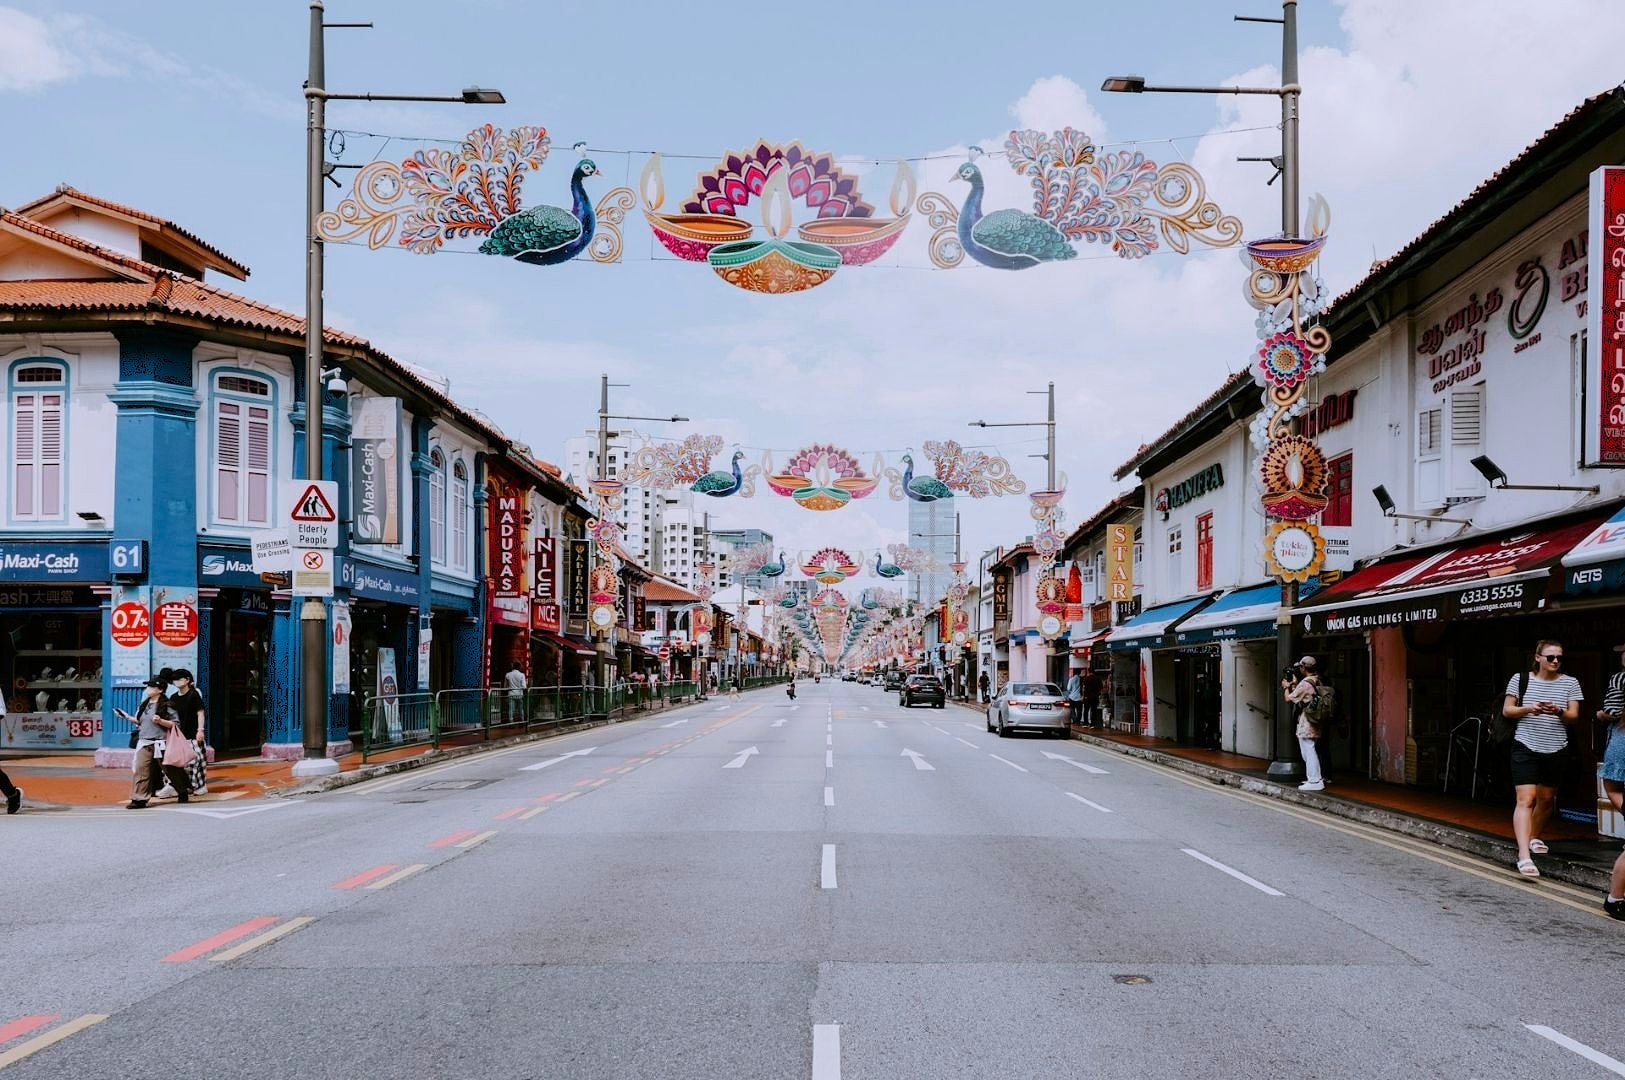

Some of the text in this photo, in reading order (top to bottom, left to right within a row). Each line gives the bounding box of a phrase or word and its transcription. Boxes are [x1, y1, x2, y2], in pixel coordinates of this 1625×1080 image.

[361, 443, 375, 514] Maxi-Cash
[298, 524, 328, 535] Elderly
[256, 539, 288, 549] PEDESTRIANS
[299, 535, 327, 545] People
[500, 497, 515, 591] MADURAS
[4, 553, 79, 569] Maxi-Cash
[113, 545, 139, 568] 61
[268, 548, 290, 557] Crossing
[1112, 526, 1128, 599] STAR
[342, 563, 355, 583] 61
[537, 538, 552, 597] NICE
[1572, 568, 1603, 584] NETS
[364, 576, 392, 592] Maxi-Cash
[1460, 588, 1489, 604] 6333
[1491, 584, 1523, 600] 5555
[112, 609, 148, 629] 0.7%
[161, 604, 190, 631] 當
[538, 605, 556, 623] NICE
[1326, 608, 1437, 631] UNION GAS HOLDINGS LIMITED
